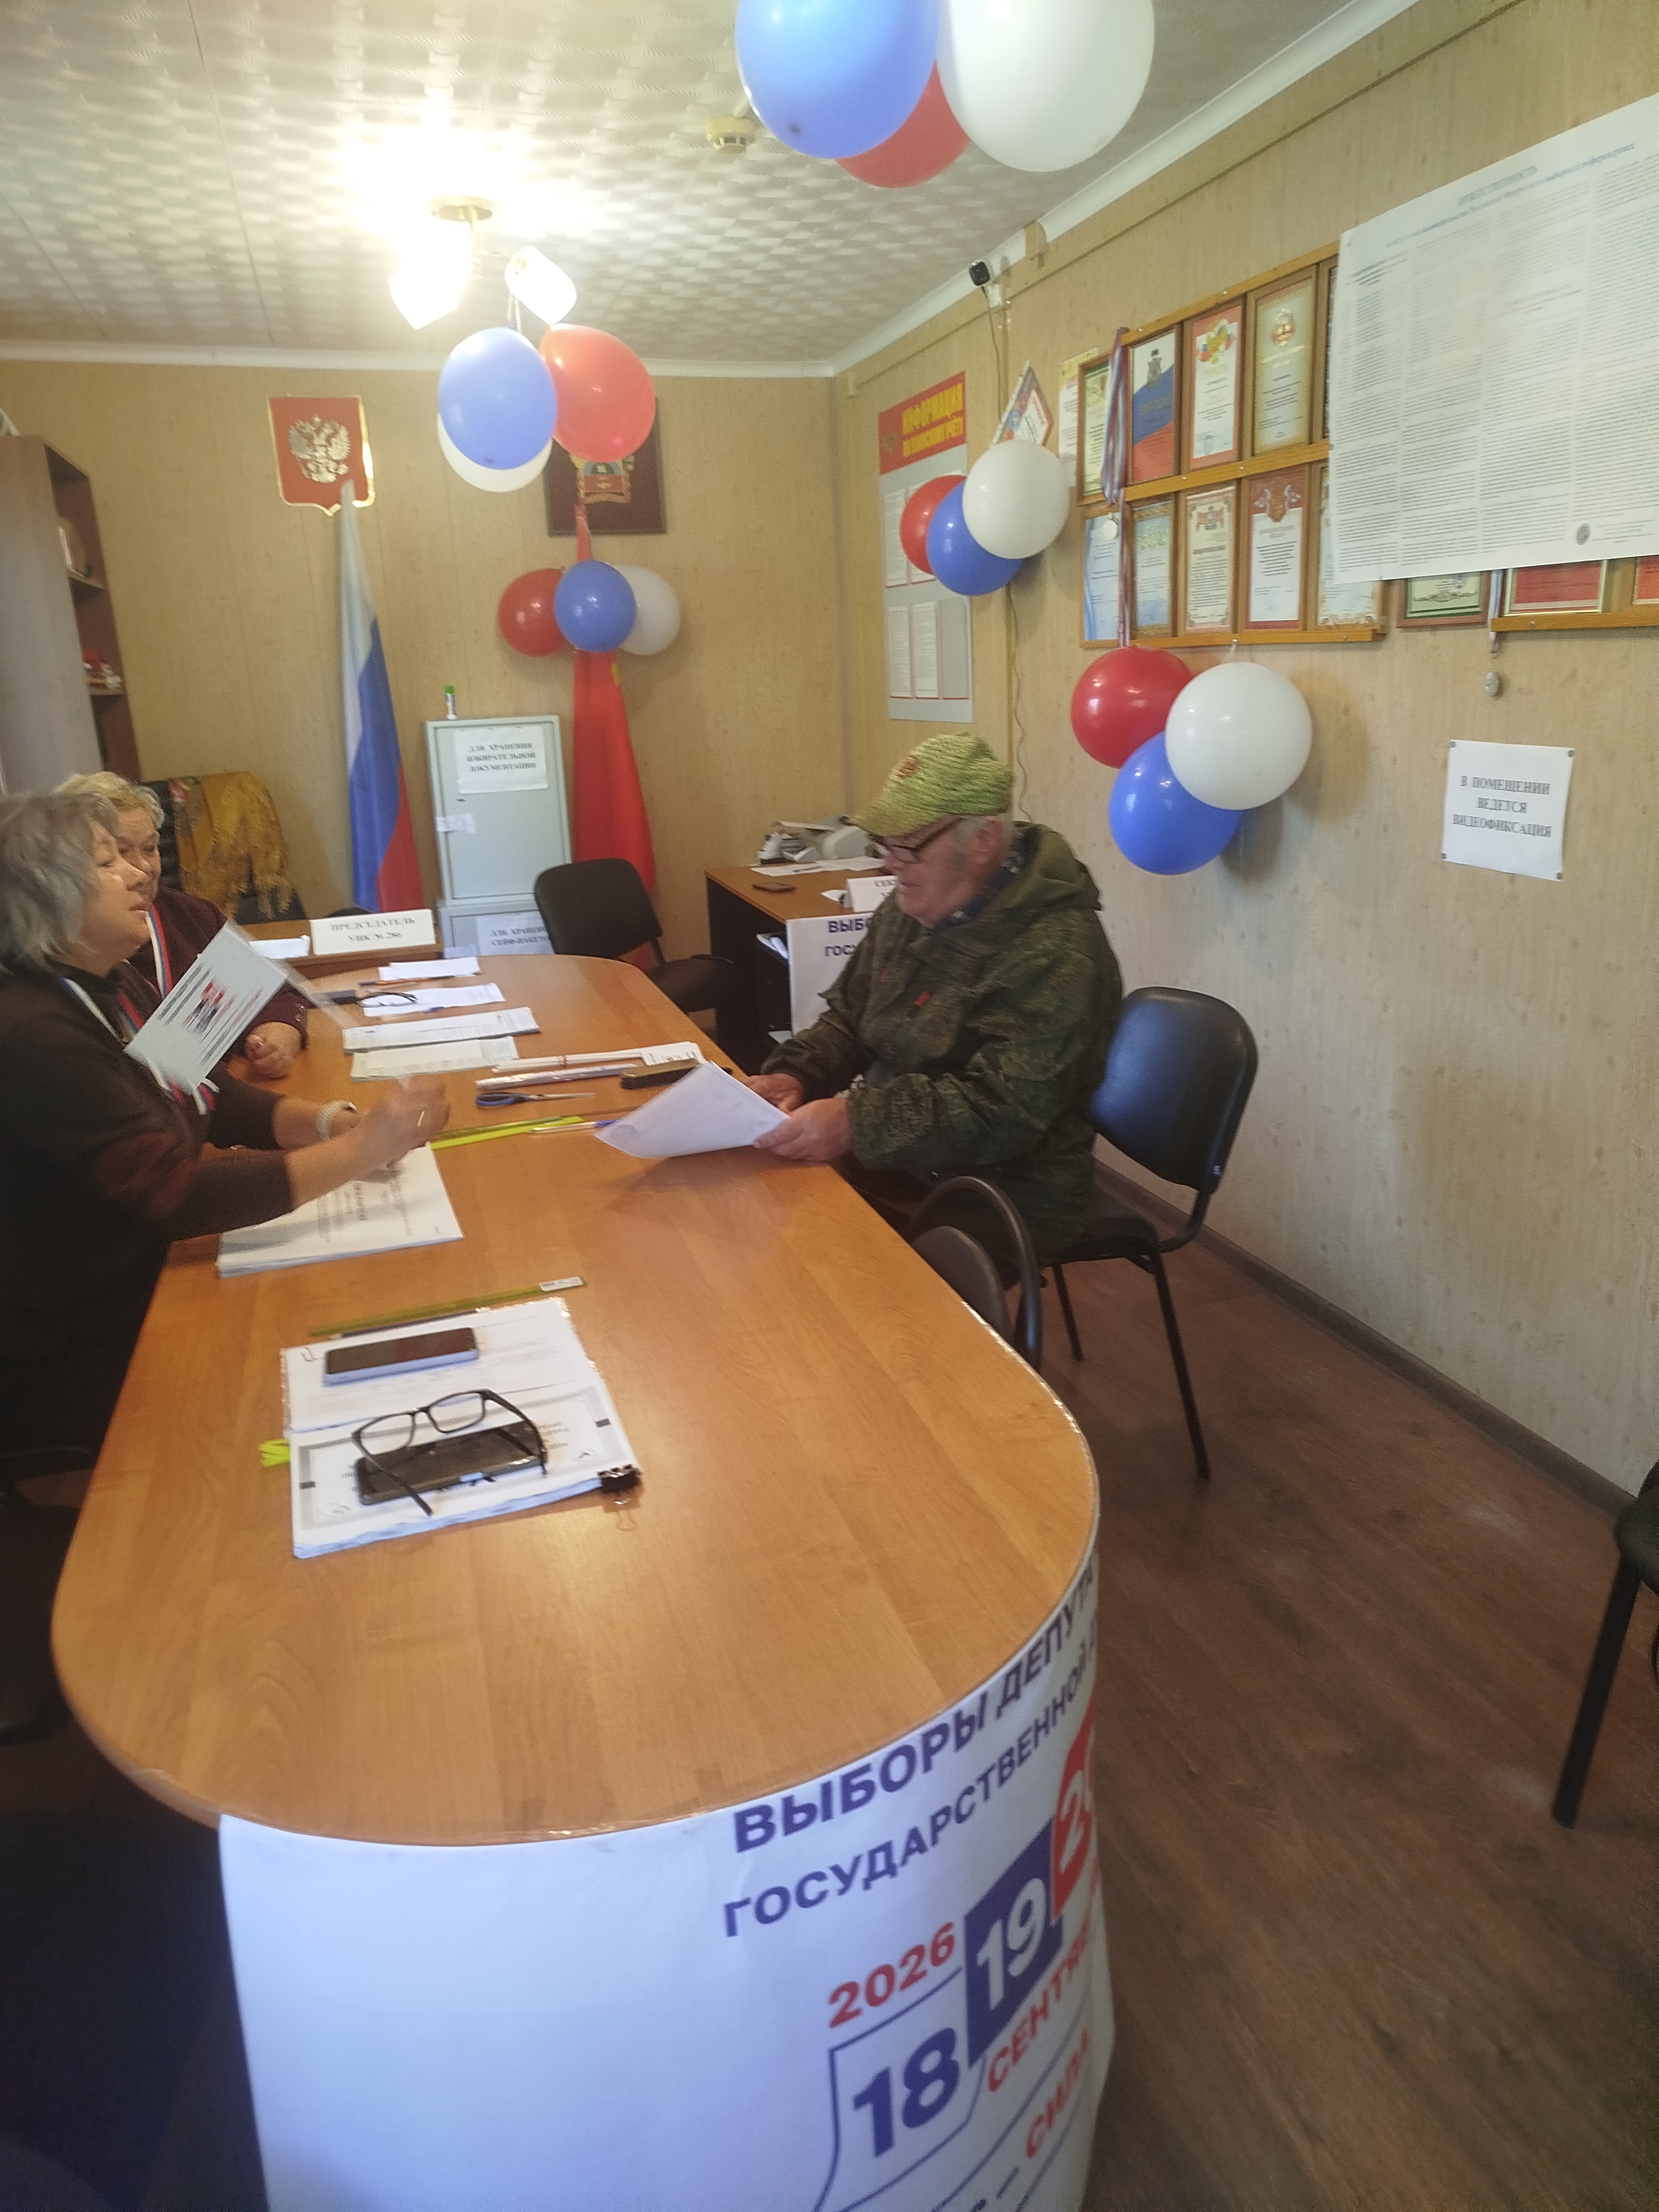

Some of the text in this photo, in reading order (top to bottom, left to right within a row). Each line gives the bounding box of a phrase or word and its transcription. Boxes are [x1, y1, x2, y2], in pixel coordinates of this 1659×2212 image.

[1460, 775, 1551, 795] В ПОМЕЩЕНИИ
[1477, 797, 1527, 813] ВЕДЕТСЯ
[1453, 814, 1552, 837] ВИДЕОФИКСАЦИЯ
[825, 944, 855, 957] ГОС
[723, 1638, 1086, 1937] ГОСУДАРСТВЕННОЙ
[734, 1691, 987, 1852] ВЫБОРЫ
[827, 1922, 956, 2029] 2026
[853, 2028, 959, 2158] 18
[977, 1878, 1046, 2011] 19
